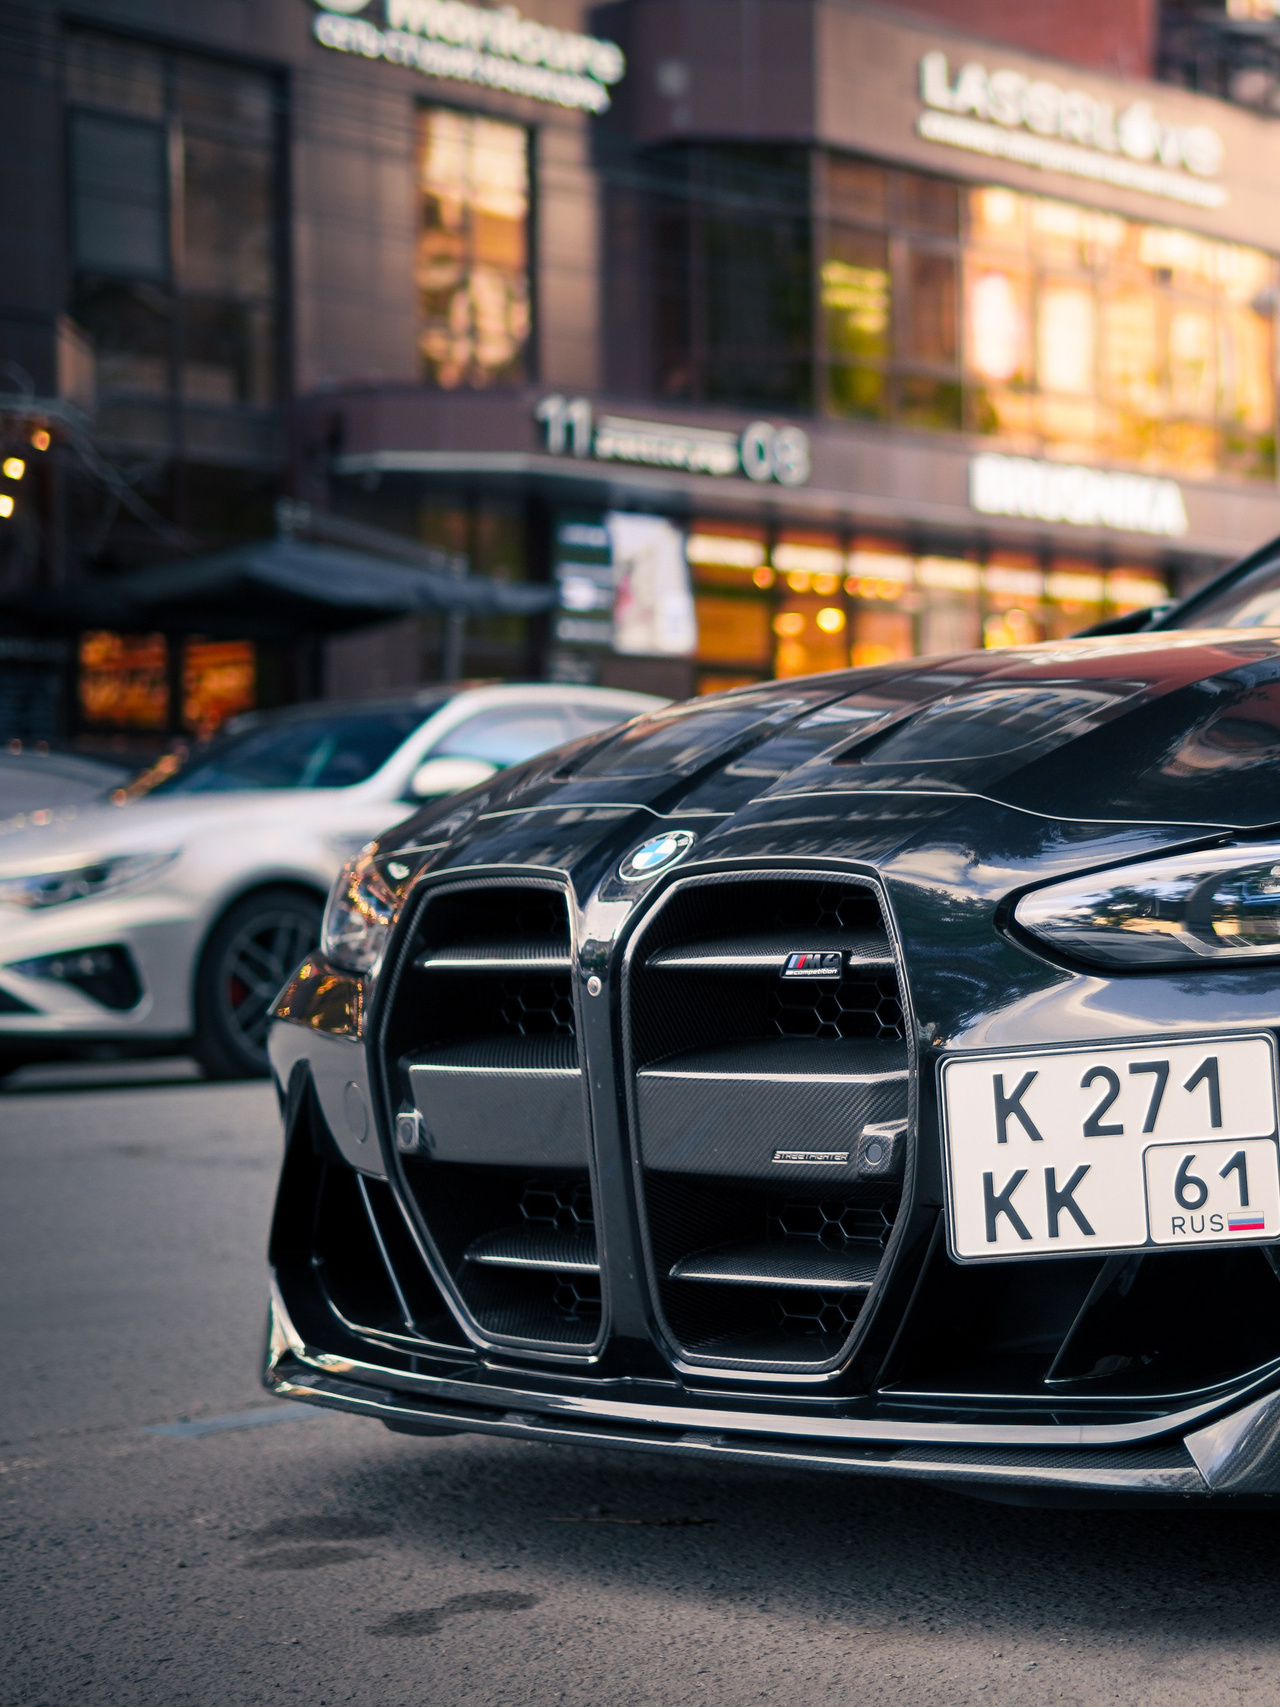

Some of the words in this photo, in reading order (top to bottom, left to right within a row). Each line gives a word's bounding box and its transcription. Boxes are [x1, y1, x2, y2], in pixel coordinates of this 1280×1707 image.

[992, 1070, 1044, 1144] K
[1080, 1056, 1223, 1138] 271
[982, 1164, 1096, 1243] KK
[1174, 1150, 1250, 1211] 61
[1172, 1214, 1225, 1236] RUS
